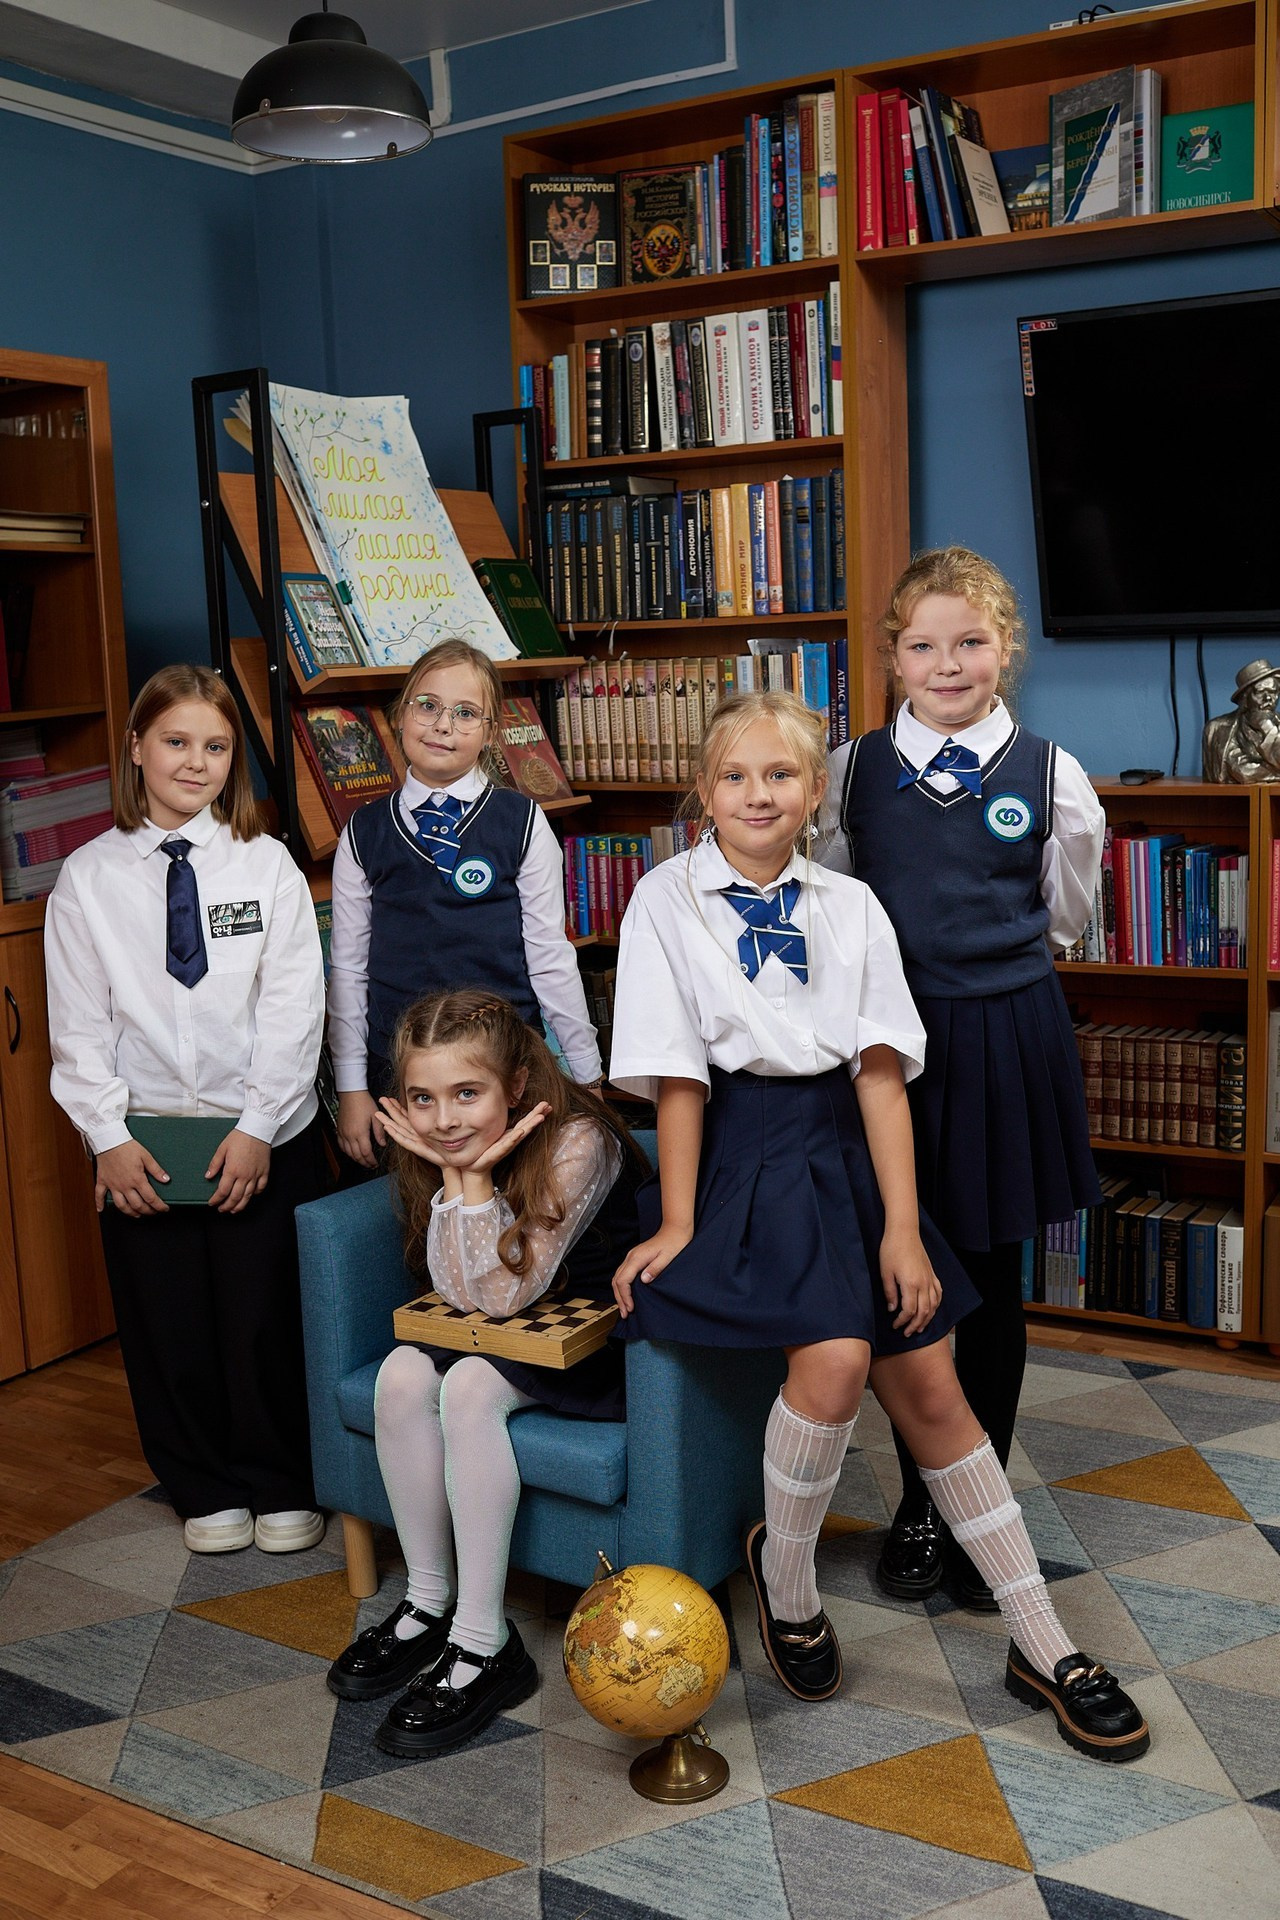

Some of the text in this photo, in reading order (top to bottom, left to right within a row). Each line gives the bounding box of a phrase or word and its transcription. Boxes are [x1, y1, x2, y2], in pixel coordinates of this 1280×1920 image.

[822, 115, 832, 161] РОССИЯ
[530, 183, 615, 194] РУССКАЯ ИСТОРИЯ
[1166, 191, 1232, 210] НОВОСИБИРСК
[788, 175, 800, 239] ИСТОРИЯ
[715, 339, 727, 436] ПОЛНЫЙ СБОРНИК КОДЕКСОВ
[748, 337, 760, 430] СБОРНИК ЗАКОНОВ
[312, 445, 386, 482] Моя
[323, 491, 412, 521] милая
[354, 533, 442, 561] малая
[687, 518, 697, 576] АСТРОНОМИЯ
[738, 540, 746, 558] МИР
[703, 535, 713, 599] КОСМОНАВТИКА
[358, 566, 455, 616] родина
[739, 564, 748, 600] ПОЗНАЮ
[837, 669, 847, 744] АТЛАС МИРА
[501, 724, 546, 745] ПОБЕДИТЕЛИ
[334, 774, 392, 791] И ПОМНИМ
[338, 760, 377, 776] ЖИВЁМ
[586, 840, 594, 850] 6
[599, 840, 606, 850] 5
[615, 842, 623, 852] 8
[629, 842, 638, 852] 9
[212, 925, 233, 937] 안녕
[1163, 1260, 1176, 1311] РУССКИЙ
